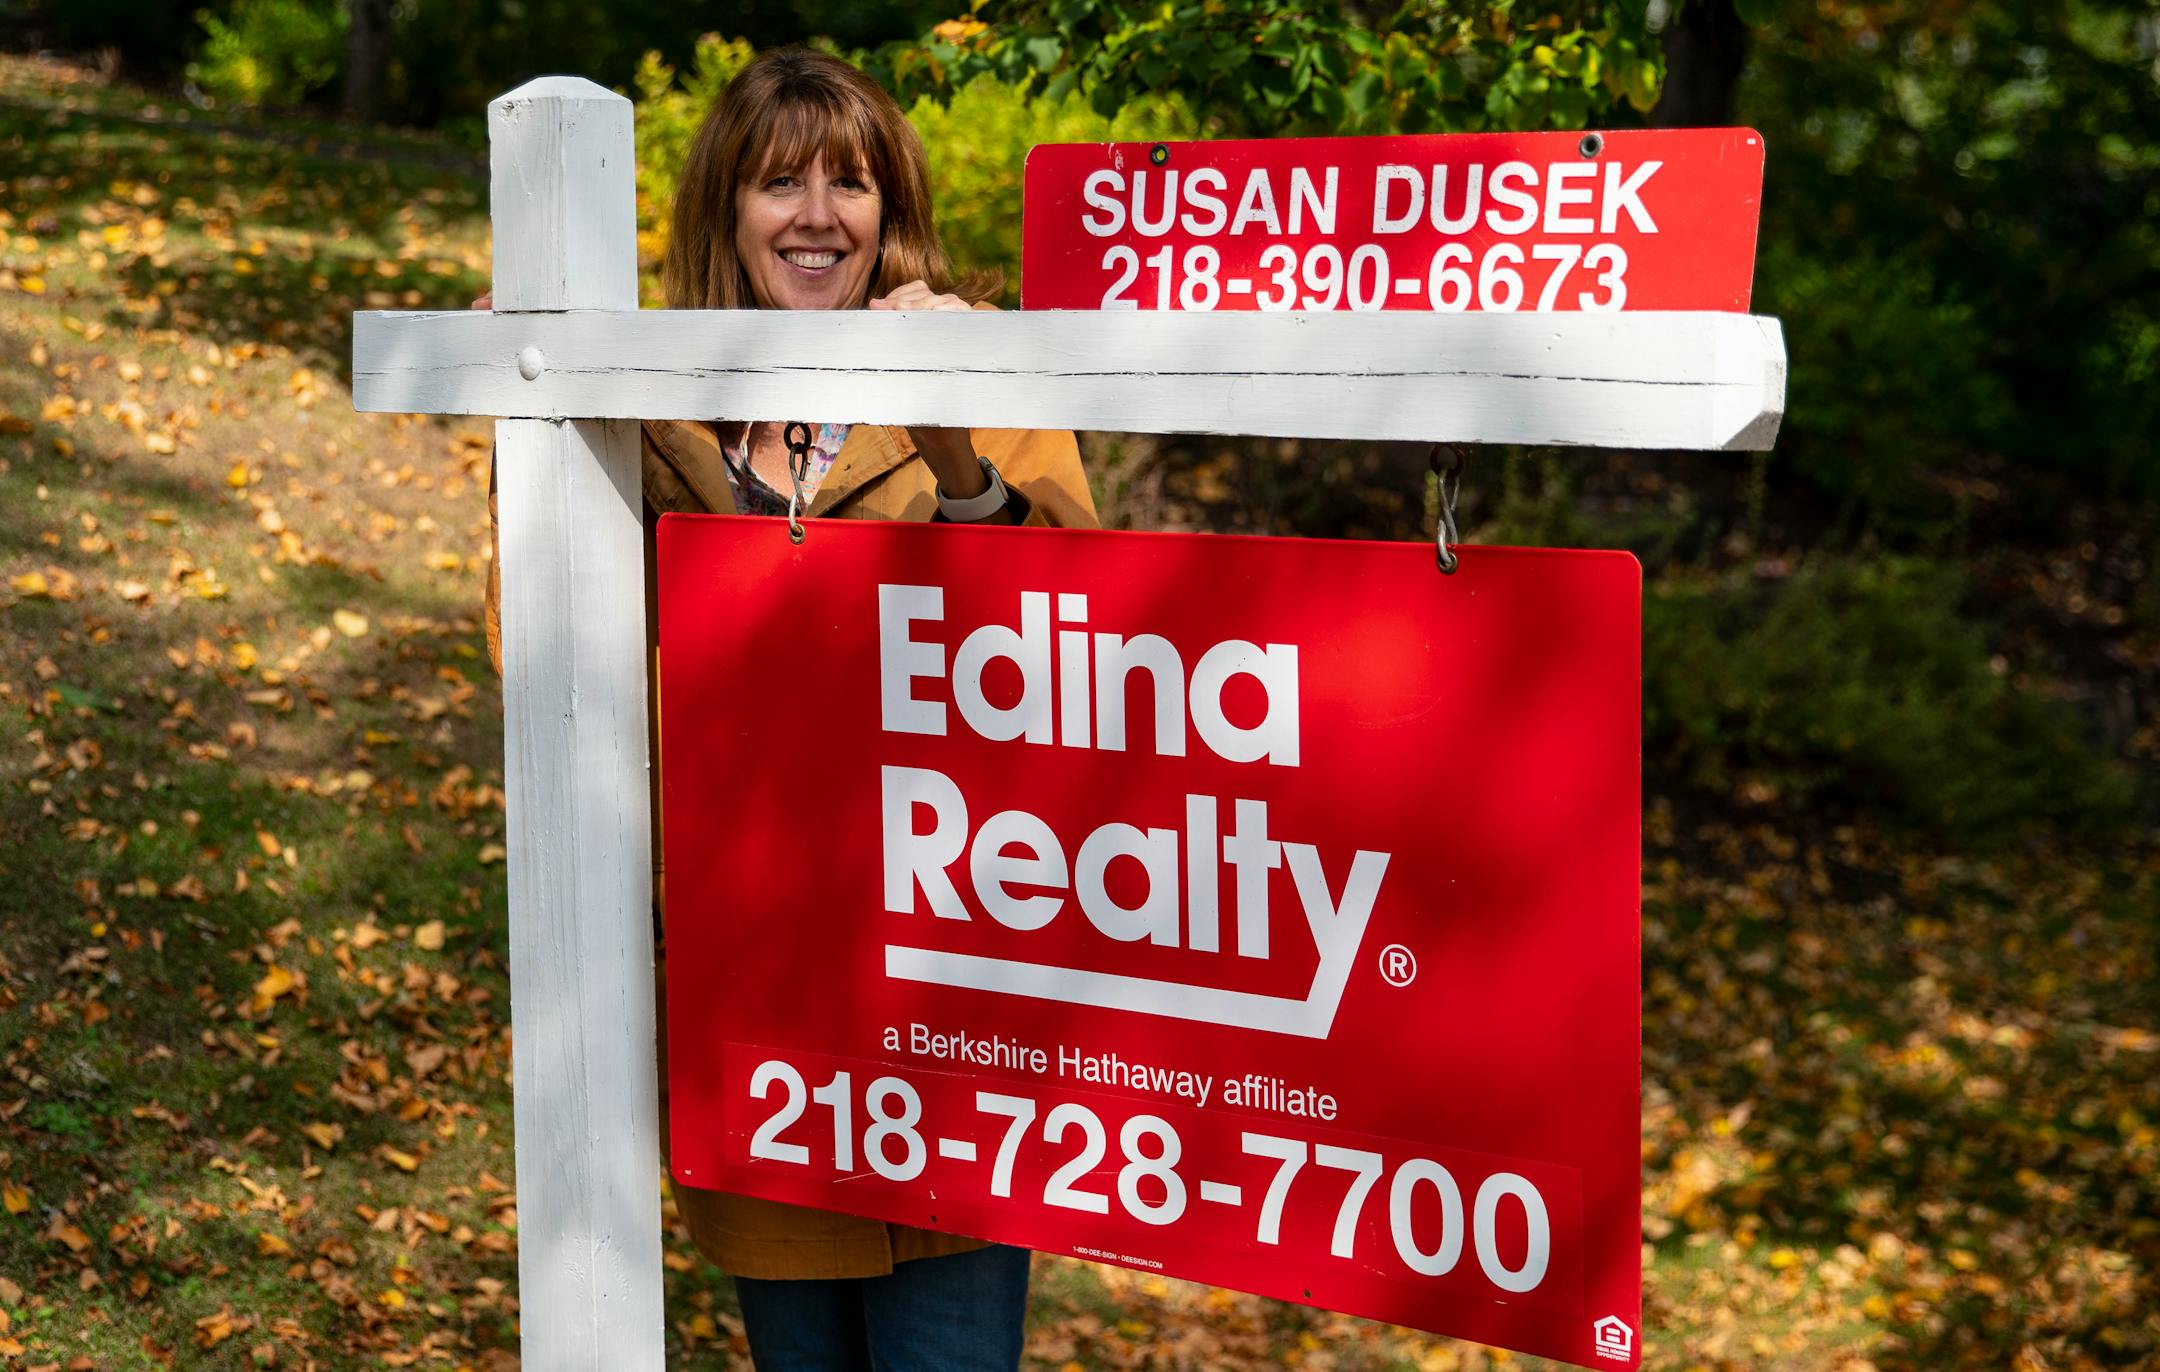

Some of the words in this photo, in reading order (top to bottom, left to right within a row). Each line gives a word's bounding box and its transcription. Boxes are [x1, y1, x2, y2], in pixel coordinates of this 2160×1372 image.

[1082, 166, 1339, 237] SUSAN
[1373, 161, 1663, 235] DUSEK
[1100, 242, 1629, 311] 218-390-6673
[878, 584, 1299, 767] Edina
[881, 765, 1392, 1039] Realty
[883, 1026, 901, 1052] a
[910, 1022, 1048, 1074] Berkshire
[1058, 1044, 1213, 1108] Hathaway
[1223, 1073, 1338, 1121] affiliate
[749, 1060, 1551, 1293] 218-728-7700
